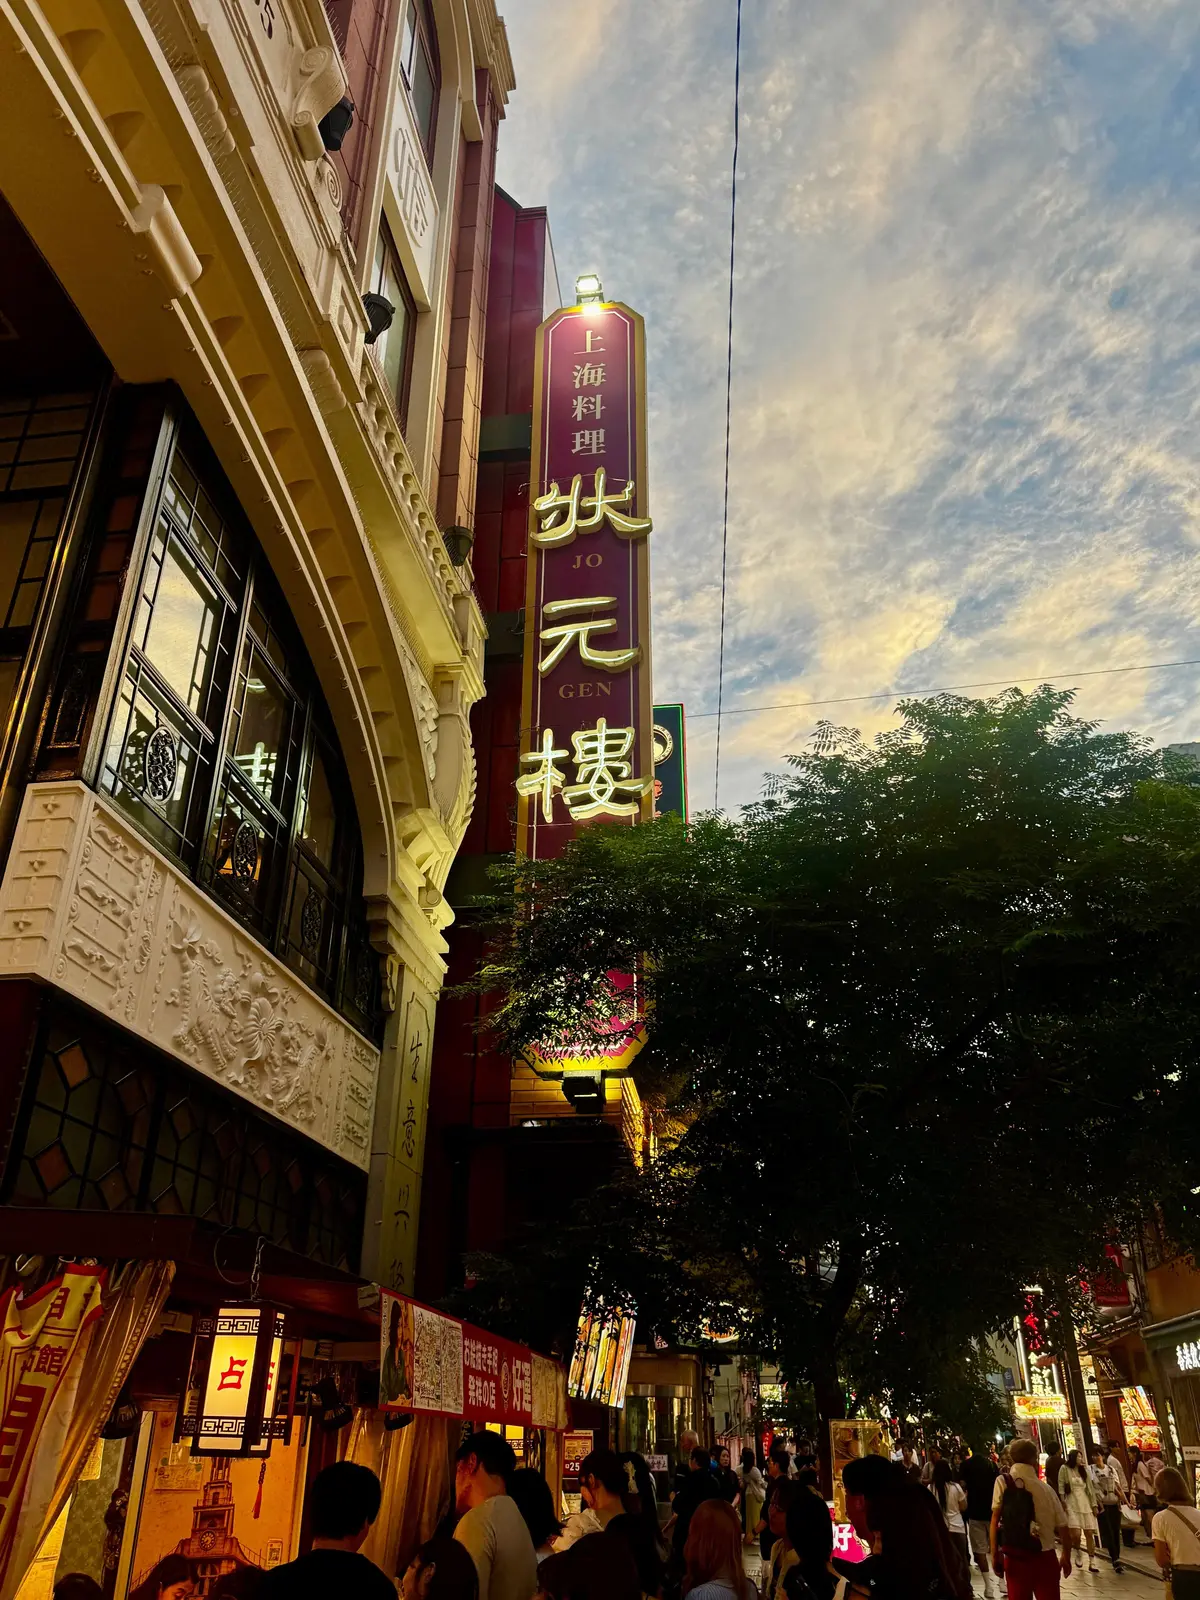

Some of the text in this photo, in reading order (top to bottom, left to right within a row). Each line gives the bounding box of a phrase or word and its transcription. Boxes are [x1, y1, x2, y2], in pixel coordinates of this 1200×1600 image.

[571, 329, 607, 456] 上海料理
[572, 553, 603, 569] JO
[558, 682, 613, 699] GEN
[217, 1356, 248, 1390] 占
